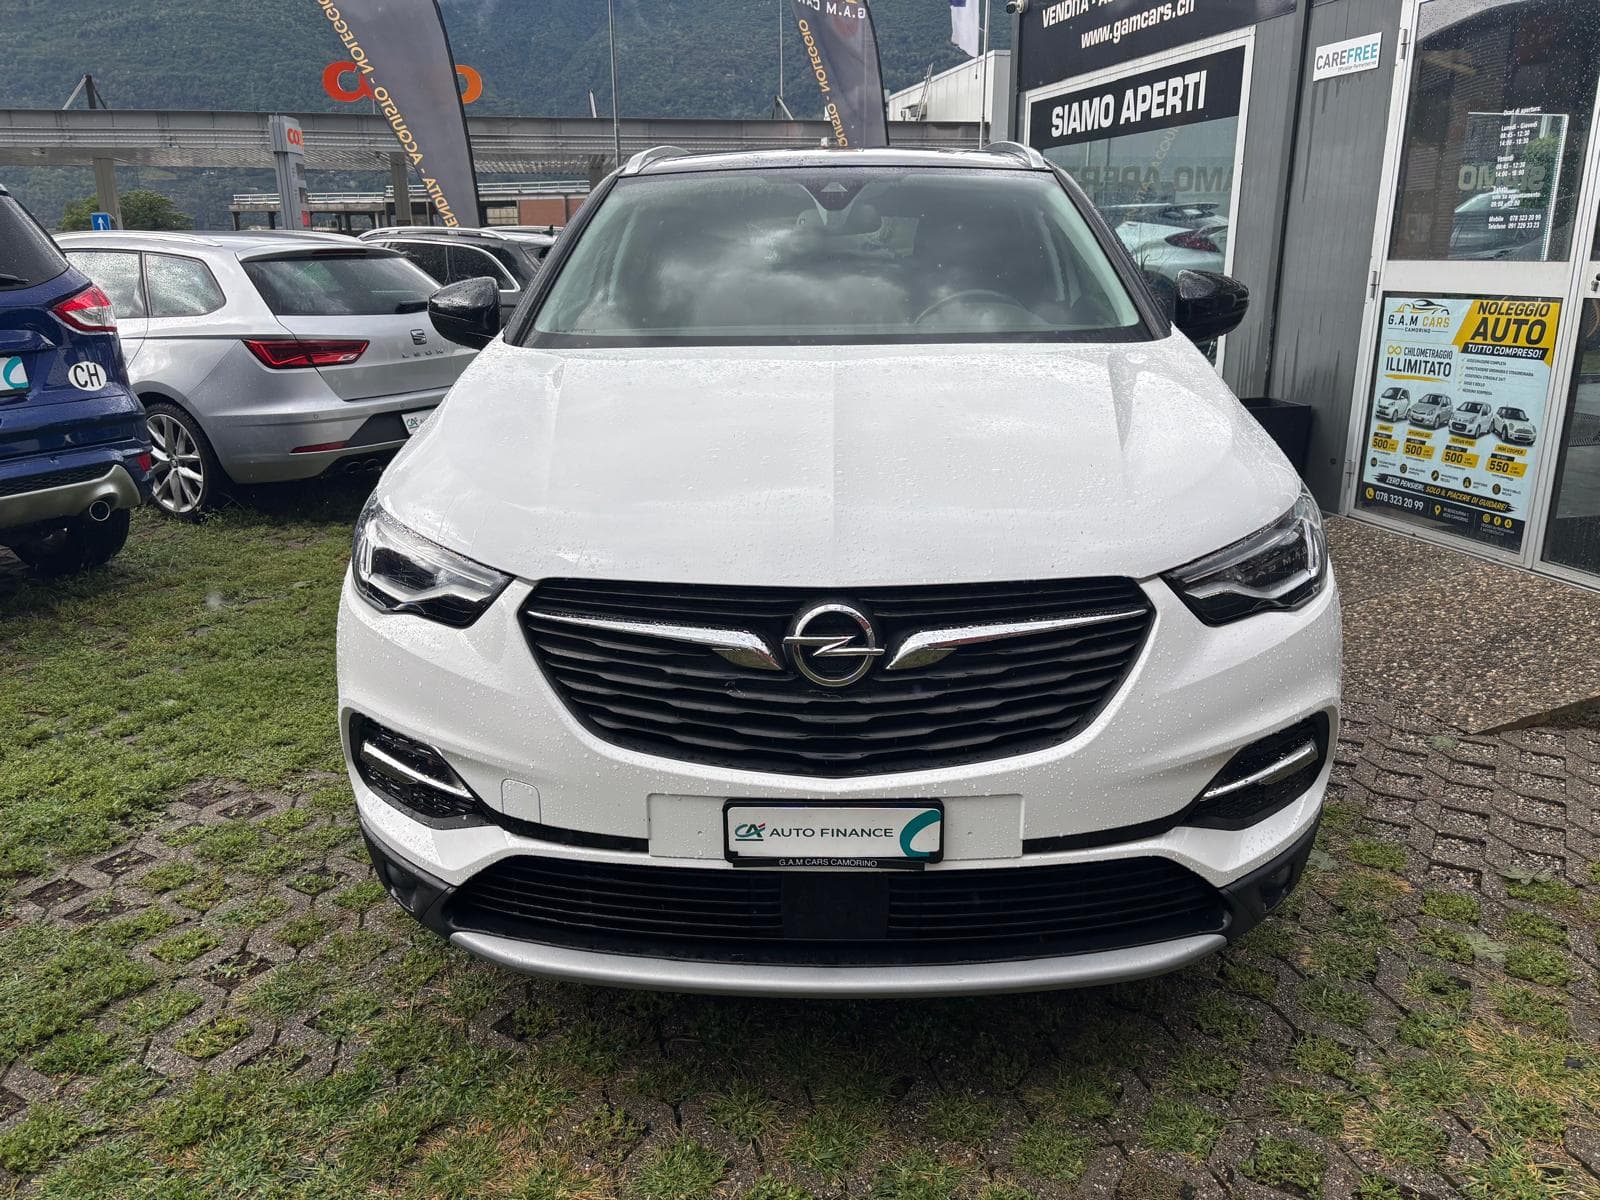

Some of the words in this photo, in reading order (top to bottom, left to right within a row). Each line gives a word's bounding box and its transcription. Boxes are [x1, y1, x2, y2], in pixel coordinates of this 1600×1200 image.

[1042, 0, 1089, 28] VENDITA
[1081, 0, 1195, 49] www.gamcars.ch
[1316, 42, 1379, 70] CAREFREE
[1051, 93, 1115, 138] SIAMO
[1119, 70, 1208, 125] APERTI
[1477, 301, 1551, 318] NOLEGGIO
[1388, 314, 1419, 327] G.A.M
[1422, 316, 1450, 328] CARS
[1470, 317, 1547, 345] AUTO
[1403, 347, 1454, 360] CHILOMETRAGGIO
[1467, 344, 1493, 354] TUTTO
[1493, 346, 1543, 358] COMPRESO!
[1386, 357, 1452, 377] ILLIMITATO
[73, 364, 102, 388] CH
[1373, 438, 1389, 449] 500
[1405, 444, 1422, 456] 500
[1445, 451, 1463, 464] 500
[1489, 460, 1509, 473] 550
[1386, 475, 1400, 485] ZERO
[1425, 485, 1441, 494] SOLO
[1446, 490, 1471, 502] PIACERE
[1375, 491, 1388, 500] 078
[1389, 494, 1402, 505] 323
[1403, 497, 1413, 507] 20
[1413, 500, 1424, 510] 99
[769, 827, 815, 838] AUTO
[820, 827, 894, 838] FINANCE
[779, 858, 804, 866] G.A.M
[805, 858, 829, 866] CARS
[830, 858, 878, 868] CAMORINO
